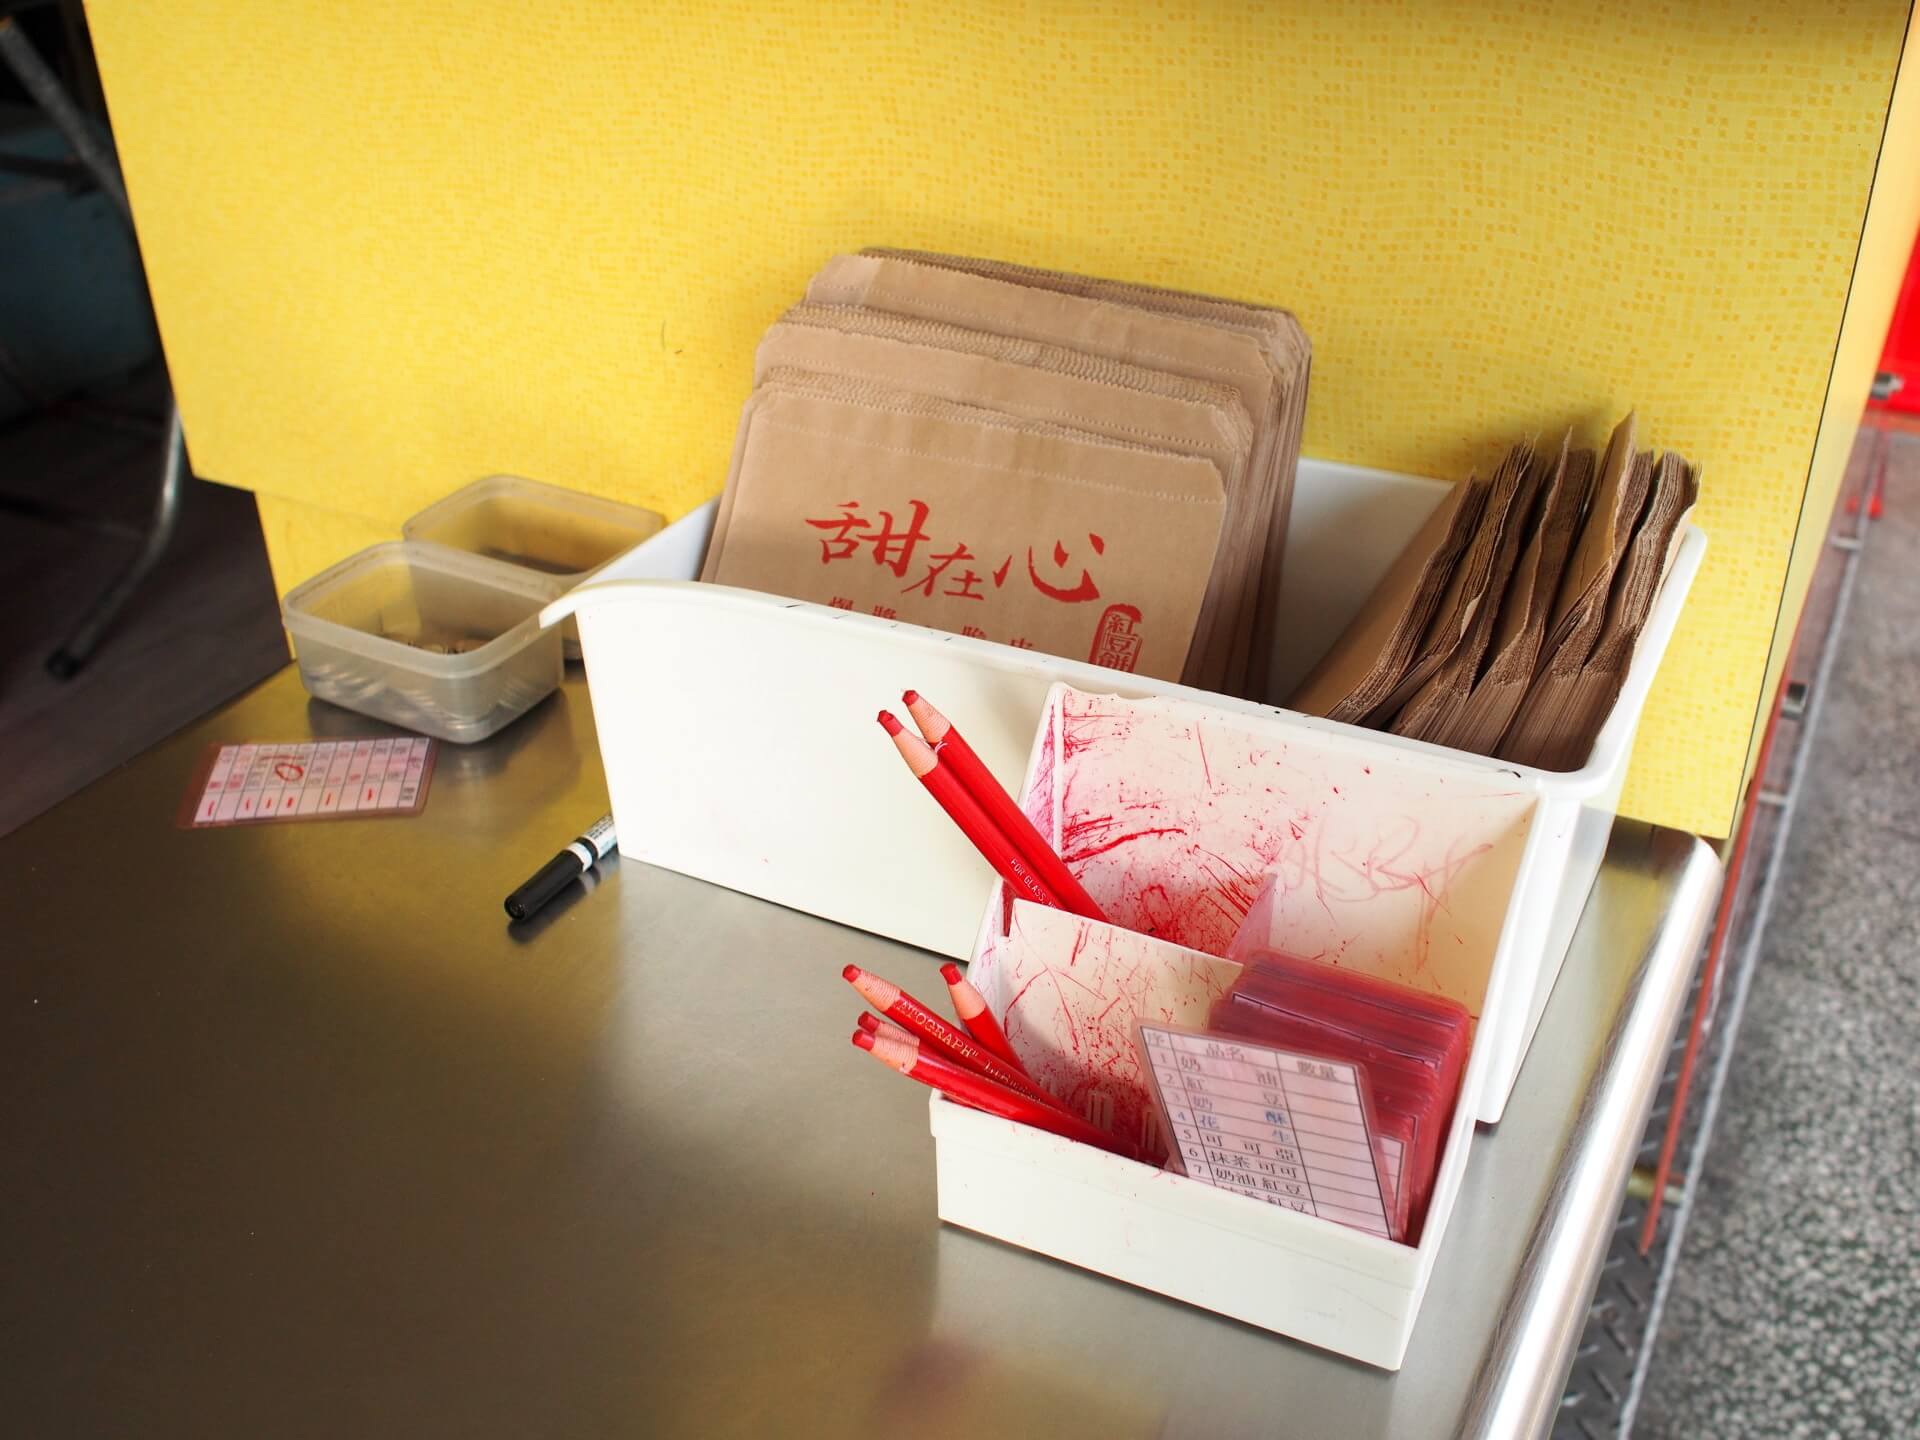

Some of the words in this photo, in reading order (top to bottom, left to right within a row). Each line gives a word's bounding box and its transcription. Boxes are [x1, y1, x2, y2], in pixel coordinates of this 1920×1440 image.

[805, 499, 1105, 603] 甜在心
[1010, 857, 1025, 876] FOR
[1205, 1042, 1245, 1062] 品名
[1164, 1073, 1174, 1084] 2
[1182, 1128, 1193, 1140] 5
[1188, 1147, 1199, 1158] 6
[1193, 1164, 1203, 1175] 7
